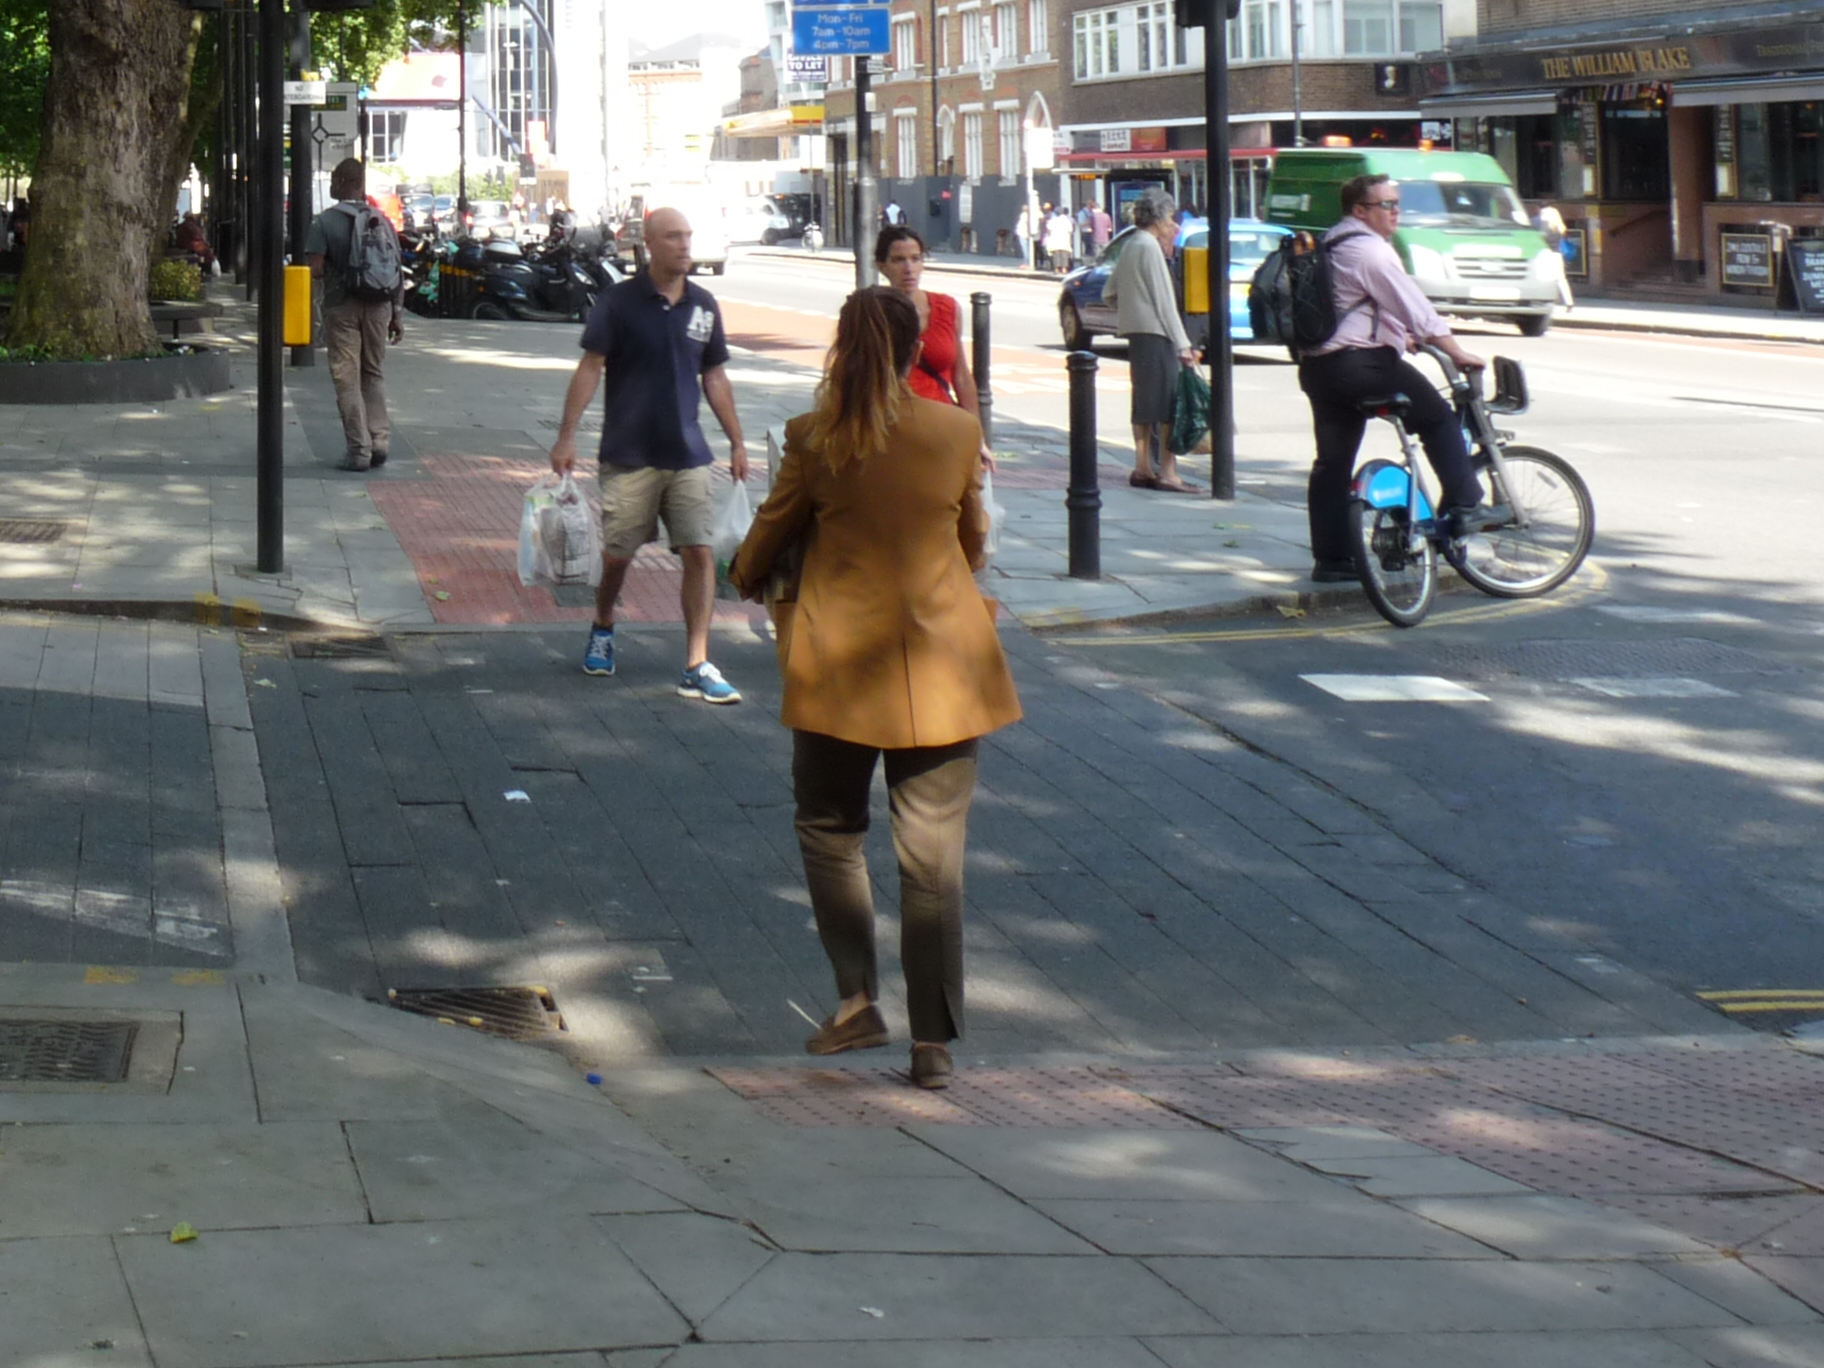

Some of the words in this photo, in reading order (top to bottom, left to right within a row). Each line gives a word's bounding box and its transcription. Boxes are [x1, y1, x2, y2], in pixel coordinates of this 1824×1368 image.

[788, 61, 804, 70] TO
[805, 60, 823, 70] LET
[1542, 57, 1570, 79] THE
[1572, 52, 1637, 75] WILLIAM
[1637, 47, 1690, 71] BLAKE
